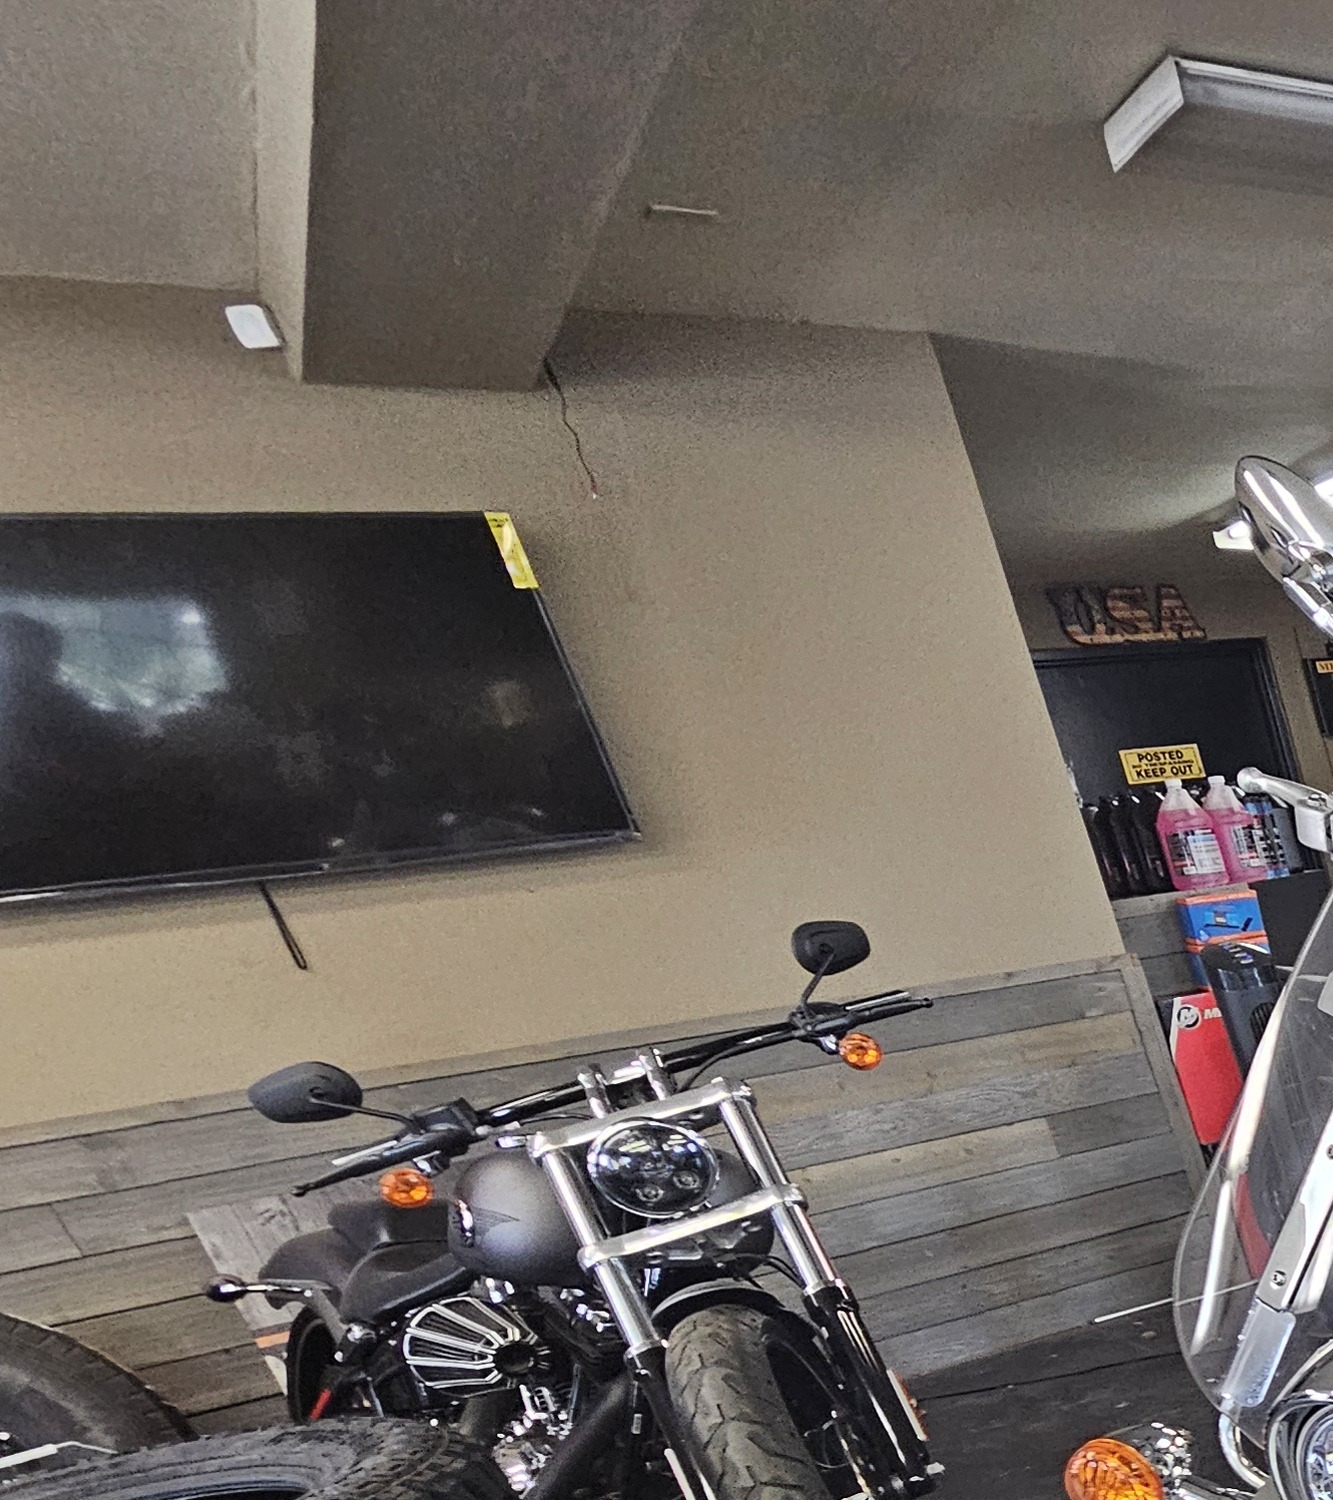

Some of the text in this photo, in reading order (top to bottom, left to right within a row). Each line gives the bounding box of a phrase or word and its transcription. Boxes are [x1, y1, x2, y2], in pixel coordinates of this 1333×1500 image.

[1045, 583, 1207, 646] USA
[1137, 750, 1184, 762] POSTED
[1135, 764, 1193, 778] KEEP OUT
